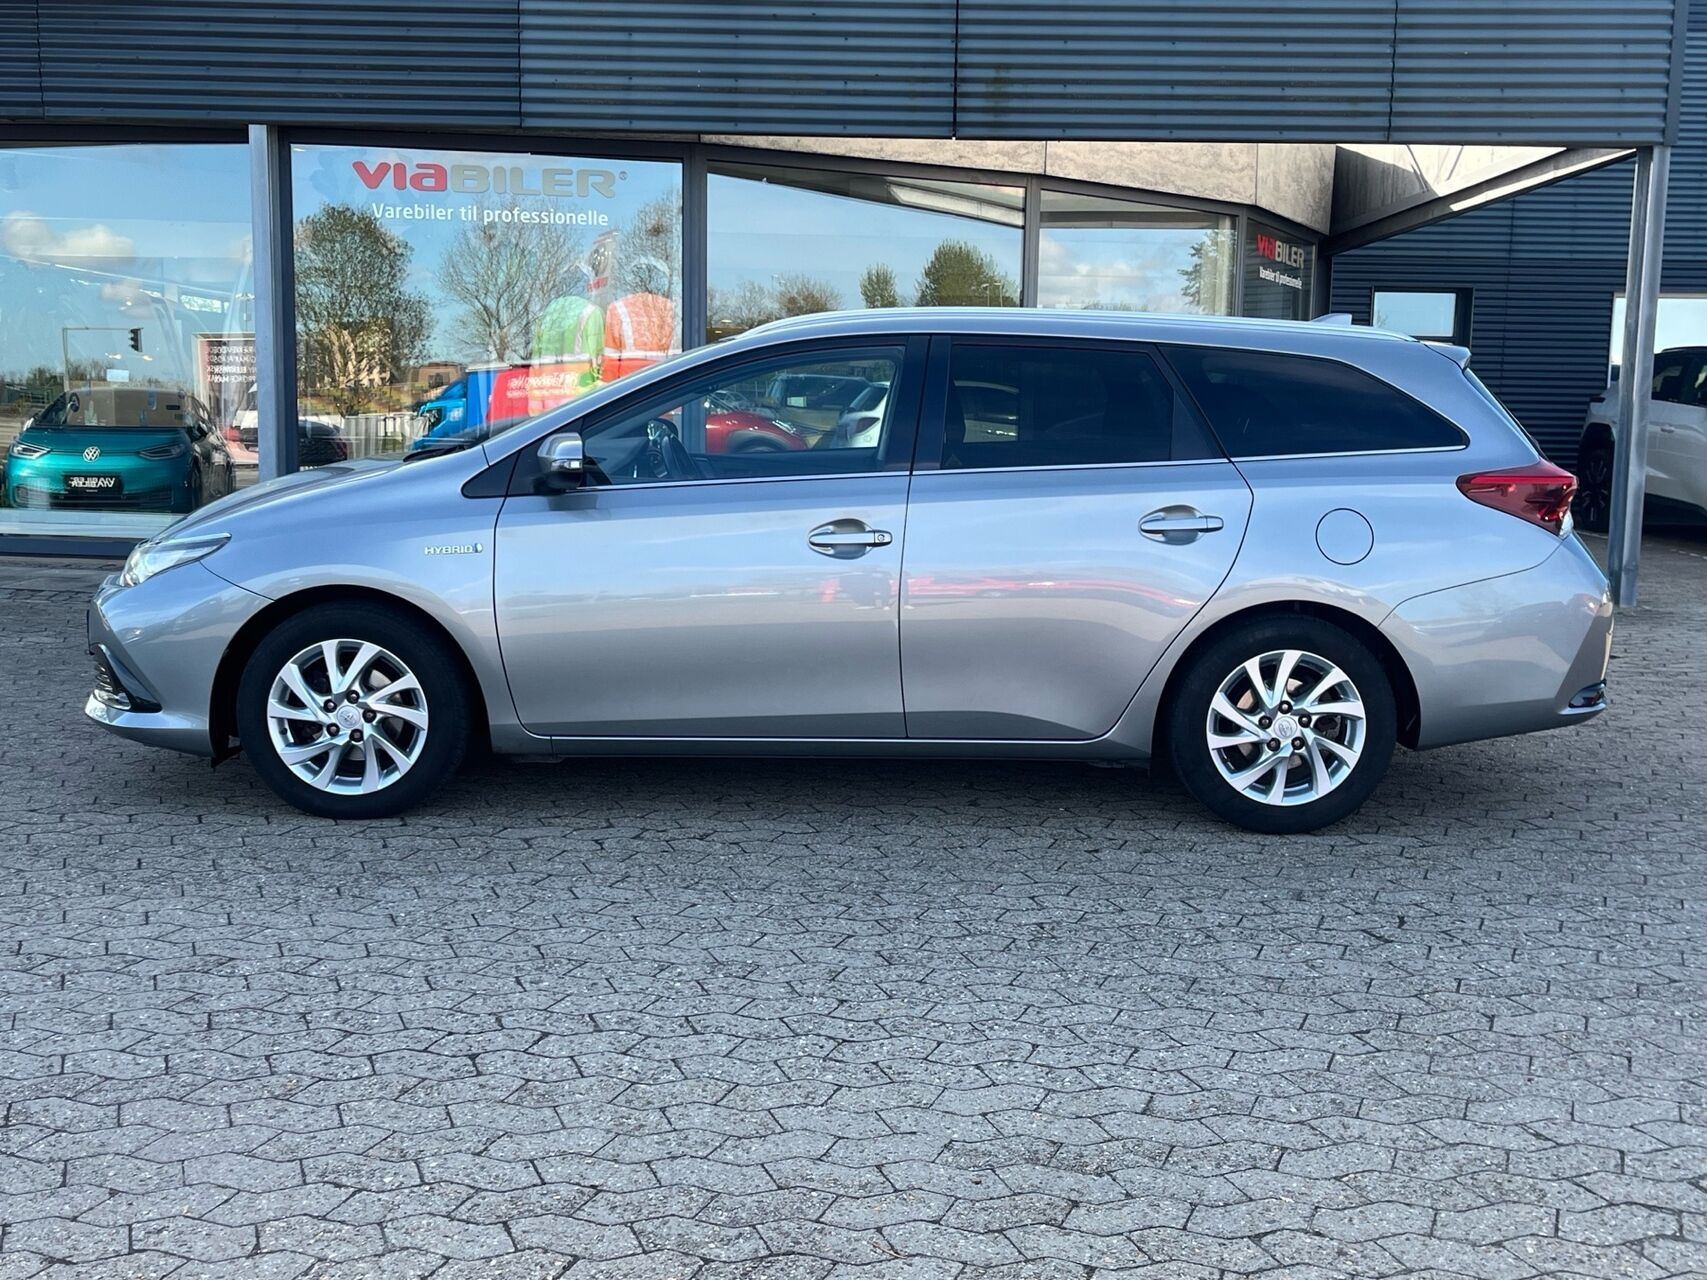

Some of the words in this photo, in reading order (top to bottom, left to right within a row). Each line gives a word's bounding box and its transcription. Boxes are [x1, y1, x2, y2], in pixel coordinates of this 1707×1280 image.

[371, 202, 454, 221] Varebiler
[459, 205, 478, 222] til
[483, 207, 609, 226] professionelle
[424, 545, 473, 555] HYBRID
